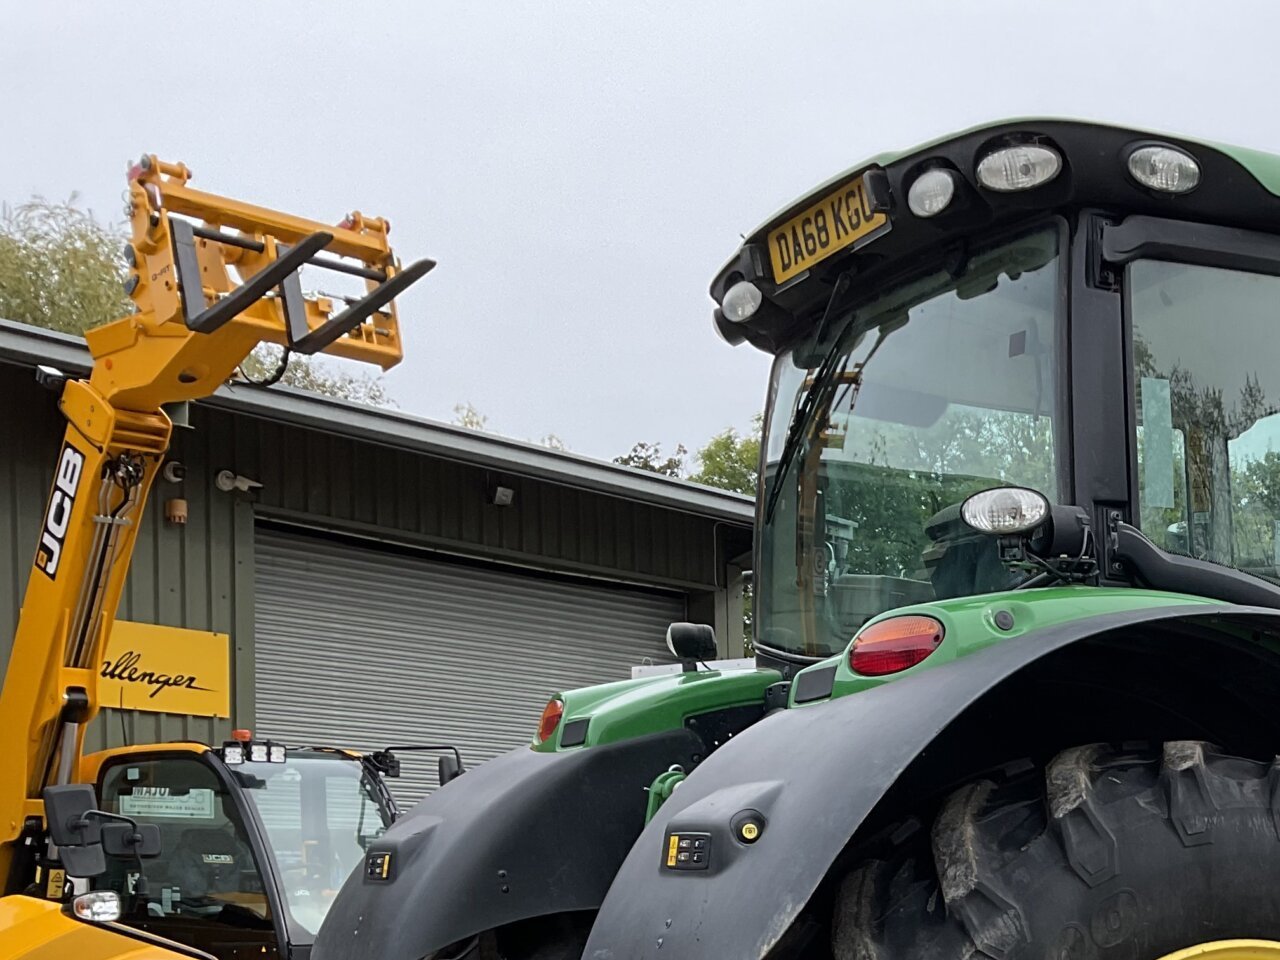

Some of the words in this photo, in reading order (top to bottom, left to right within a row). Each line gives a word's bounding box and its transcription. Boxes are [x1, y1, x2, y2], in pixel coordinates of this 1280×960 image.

[776, 209, 830, 273] DA68
[44, 447, 84, 575] JCB
[100, 651, 219, 697] allenger
